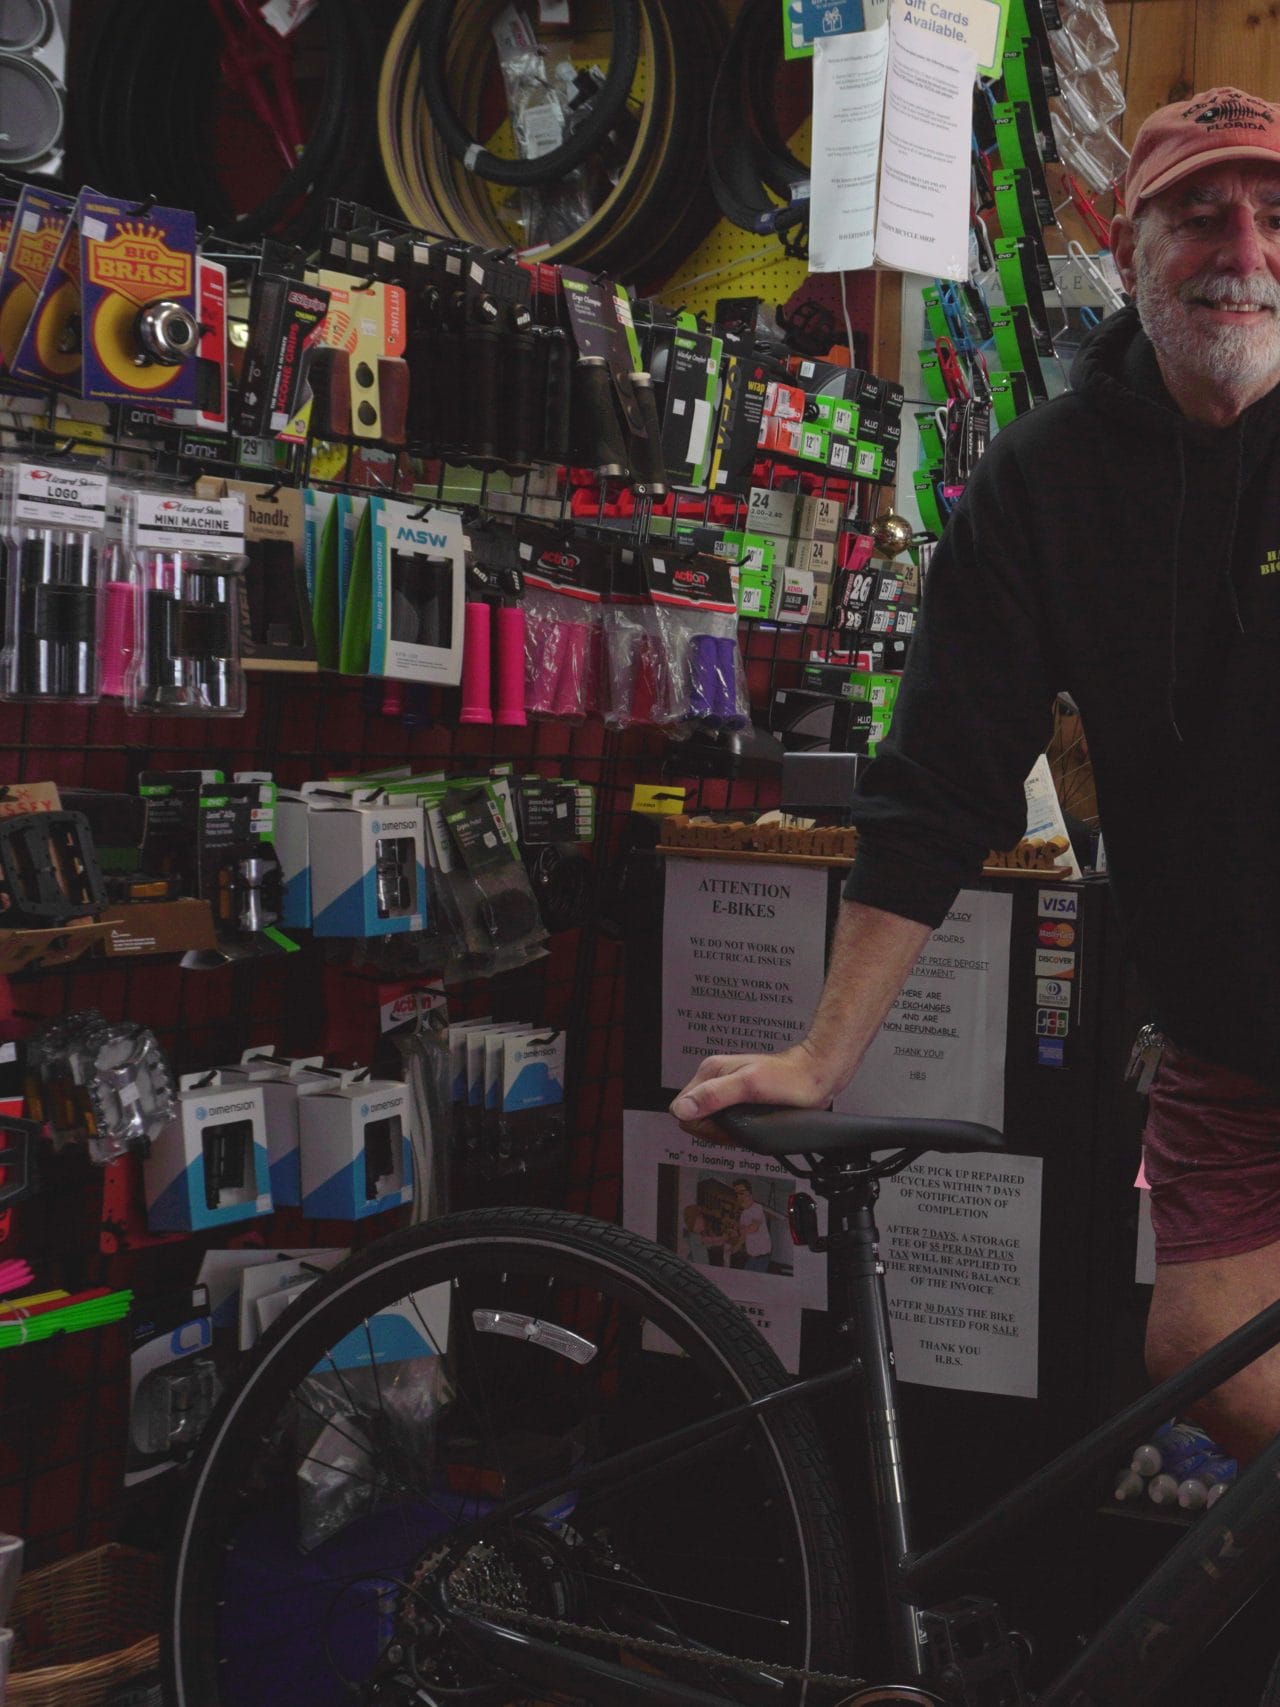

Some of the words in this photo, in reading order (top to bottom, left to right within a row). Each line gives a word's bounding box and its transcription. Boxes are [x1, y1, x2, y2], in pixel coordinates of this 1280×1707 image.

[929, 3, 970, 27] Cards
[903, 10, 968, 43] Available.
[1206, 120, 1267, 132] FLORIDA
[123, 245, 160, 261] BIG
[96, 257, 185, 287] BRASS
[48, 486, 78, 500] LOGO
[751, 491, 770, 509] 24
[248, 504, 290, 528] handlz
[819, 502, 830, 517] 24
[154, 514, 179, 526] MINI
[181, 517, 230, 531] MACHINE
[396, 526, 448, 549] MSW
[812, 543, 824, 559] 24
[849, 573, 872, 602] 26
[698, 878, 792, 899] ATTENTION
[712, 899, 776, 919] E-BIKES
[1042, 898, 1077, 913] VISA
[689, 936, 706, 947] WE
[708, 937, 722, 948] DO
[724, 939, 745, 951] NOT
[747, 942, 778, 954] WORK
[780, 945, 796, 955] ON
[932, 933, 967, 944] ORDERS
[692, 949, 757, 964] ELECTRICAL
[758, 956, 792, 968] ISSUES
[929, 956, 952, 968] PRICE
[954, 958, 990, 971] DEPOSIT
[1038, 954, 1073, 965] DISCOVER
[694, 974, 711, 984] WE
[712, 975, 740, 988] ONLY
[741, 978, 772, 991] WORK
[774, 981, 790, 992] ON
[689, 986, 757, 1002] MECHANICAL
[759, 993, 793, 1005] ISSUES
[925, 990, 942, 1000] ARE
[902, 1000, 952, 1013] EXCHANGES
[677, 1008, 693, 1019] WE
[693, 1009, 716, 1021] ARE
[717, 1012, 738, 1023] NOT
[739, 1014, 806, 1031] RESPONSIBLE
[882, 1022, 902, 1033] NON
[901, 1013, 920, 1022] AND
[921, 1014, 939, 1023] ARE
[687, 1021, 708, 1032] FOR
[709, 1024, 729, 1034] ANY
[731, 1026, 794, 1042] ELECTRICAL
[706, 1034, 739, 1047] ISSUES
[740, 1039, 775, 1052] FOUND
[893, 1046, 921, 1058] THANK
[687, 1153, 698, 1163] to
[702, 1154, 735, 1170] loaning
[739, 1158, 761, 1172] shop
[765, 1160, 789, 1174] tools
[927, 1166, 953, 1178] PICK
[955, 1168, 970, 1179] UP
[970, 1170, 1025, 1185] REPAIRED
[890, 1174, 941, 1188] BICYCLES
[942, 1180, 983, 1194] WITHIN
[993, 1185, 1021, 1198] DAYS
[899, 1187, 914, 1198] OF
[915, 1189, 992, 1207] NOTIFICATION
[993, 1198, 1009, 1209] OF
[918, 1203, 989, 1219] COMPLETION
[886, 1223, 921, 1236] AFTER
[970, 1234, 1021, 1249] STORAGE
[891, 1237, 912, 1247] FEE
[913, 1239, 928, 1249] OF
[942, 1242, 962, 1254] PER
[962, 1245, 986, 1257] DAY
[987, 1248, 1016, 1261] PLUS
[888, 1249, 910, 1261] TAX
[911, 1250, 940, 1263] WILL
[940, 1254, 954, 1264] BE
[955, 1256, 1002, 1272] APPLIED
[1002, 1262, 1018, 1273] TO
[885, 1260, 906, 1272] THE
[908, 1262, 970, 1280] REMAINING
[971, 1270, 1021, 1287] BALANCE
[910, 1275, 926, 1286] OF
[926, 1278, 949, 1289] THE
[950, 1280, 995, 1296] INVOICE
[889, 1298, 923, 1311] AFTER
[924, 1301, 935, 1312] 30
[936, 1303, 965, 1317] DAYS
[966, 1307, 989, 1319] THE
[989, 1311, 1016, 1323] BIKE
[913, 1313, 928, 1323] BE
[928, 1315, 967, 1329] LISTED
[968, 1320, 991, 1332] FOR
[991, 1323, 1020, 1338] SALE
[919, 1339, 957, 1353] THANK
[957, 1344, 981, 1356] YOU
[935, 1354, 963, 1367] H.B.S.
